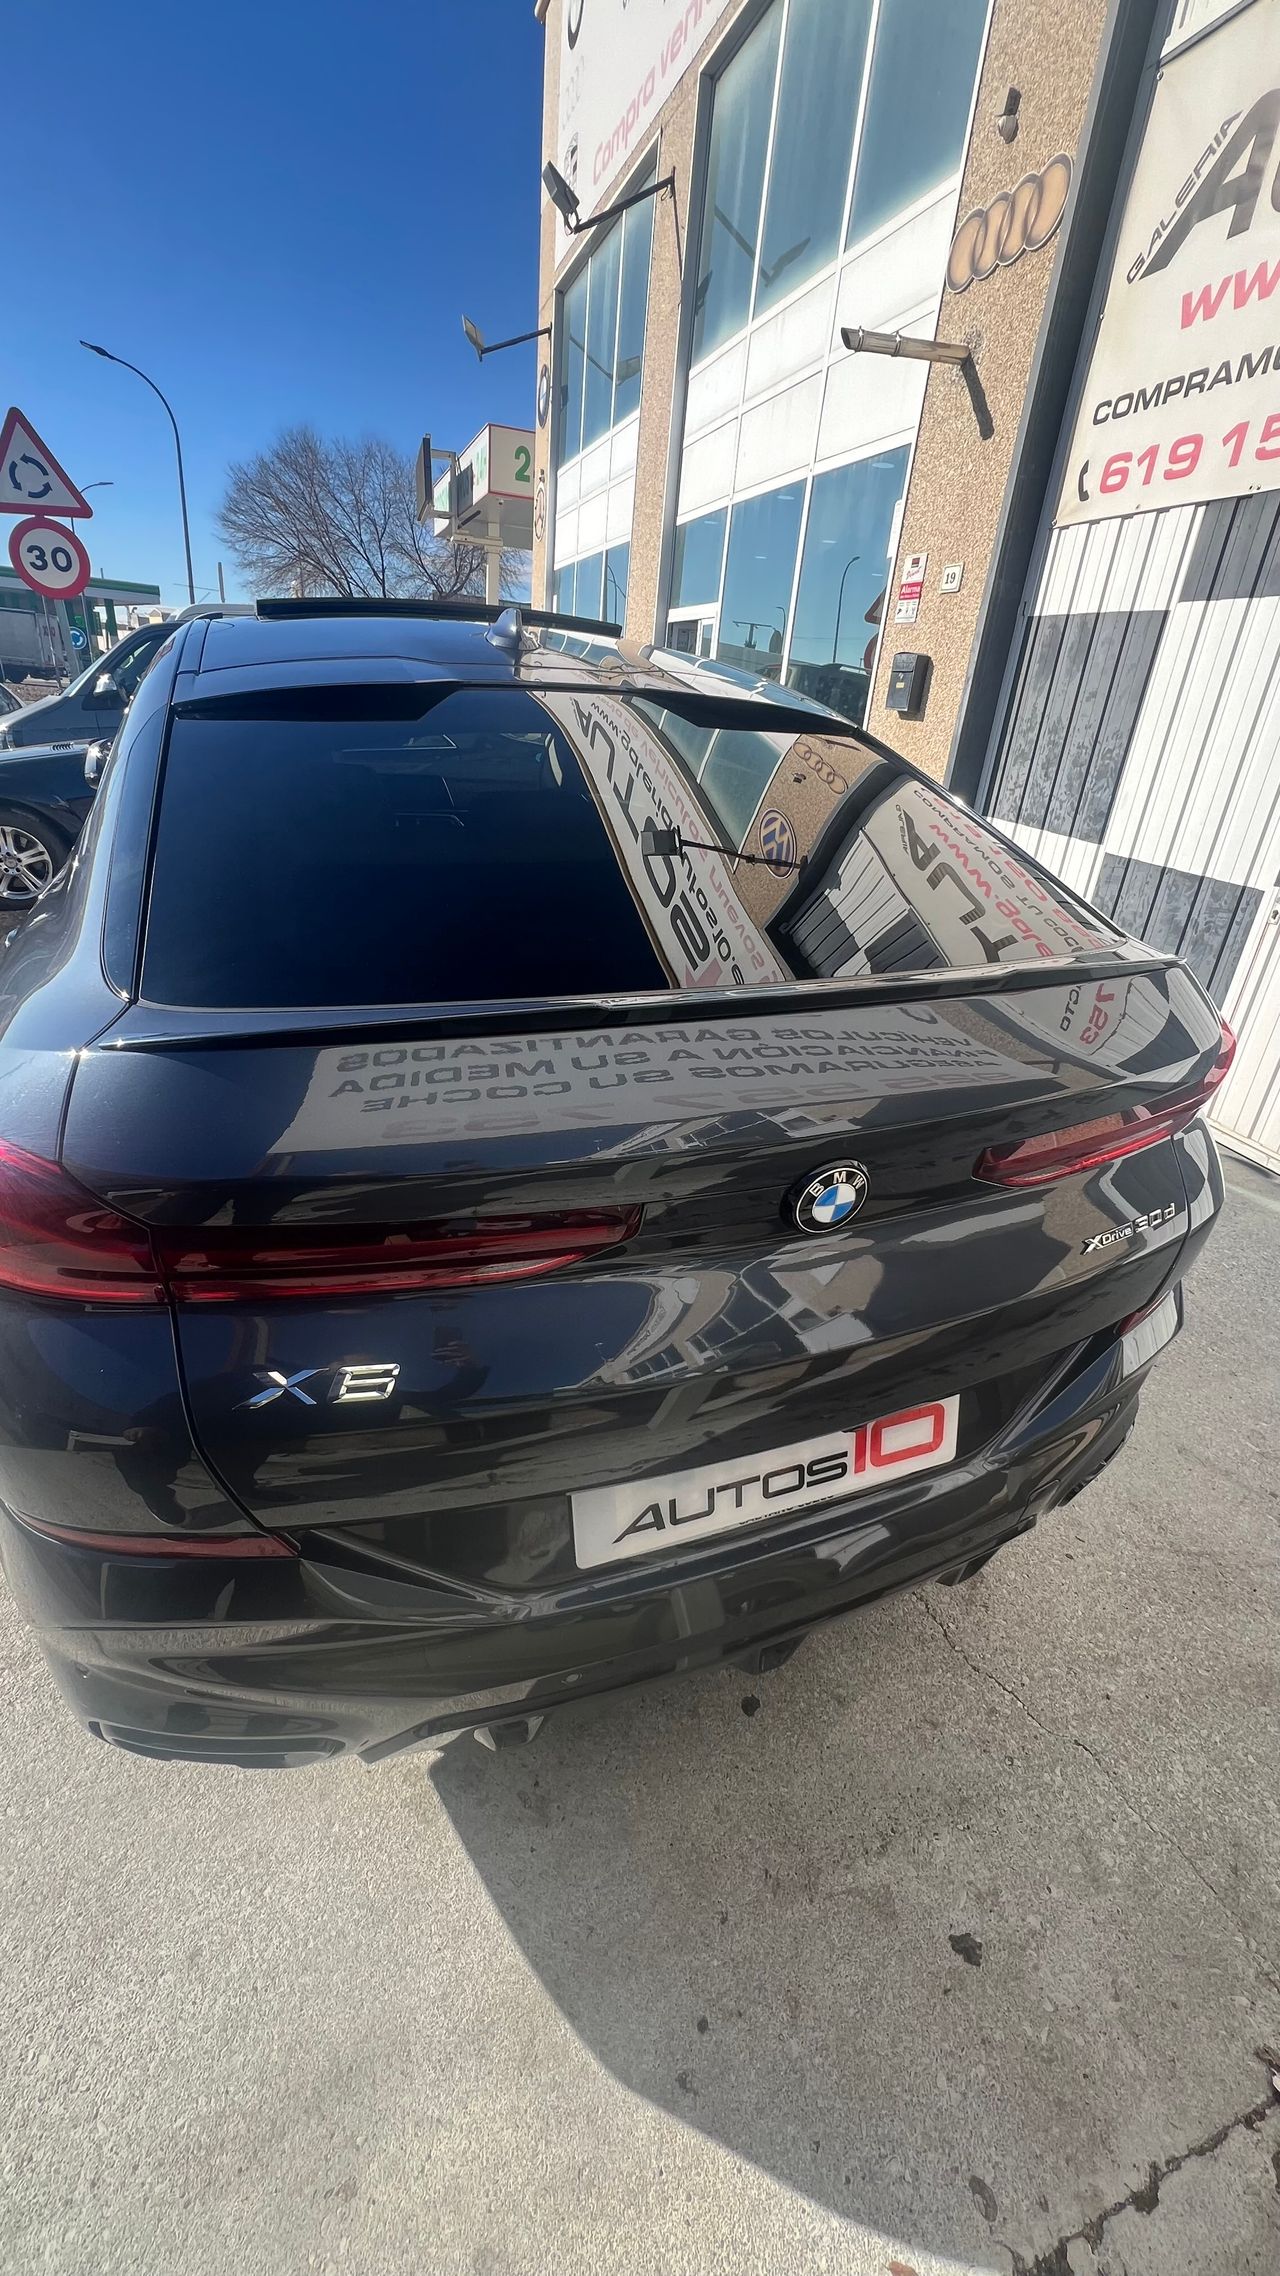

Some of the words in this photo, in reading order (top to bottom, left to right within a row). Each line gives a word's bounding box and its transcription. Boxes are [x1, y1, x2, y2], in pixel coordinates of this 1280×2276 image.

[592, 65, 656, 186] Compro
[1126, 109, 1244, 285] GALERIA
[1092, 344, 1280, 426] COMPRAM
[1099, 434, 1204, 494] 619
[26, 544, 73, 573] 30
[944, 572, 956, 585] 19
[809, 1170, 866, 1198] BMW
[612, 1402, 946, 1545] AUTOS10
